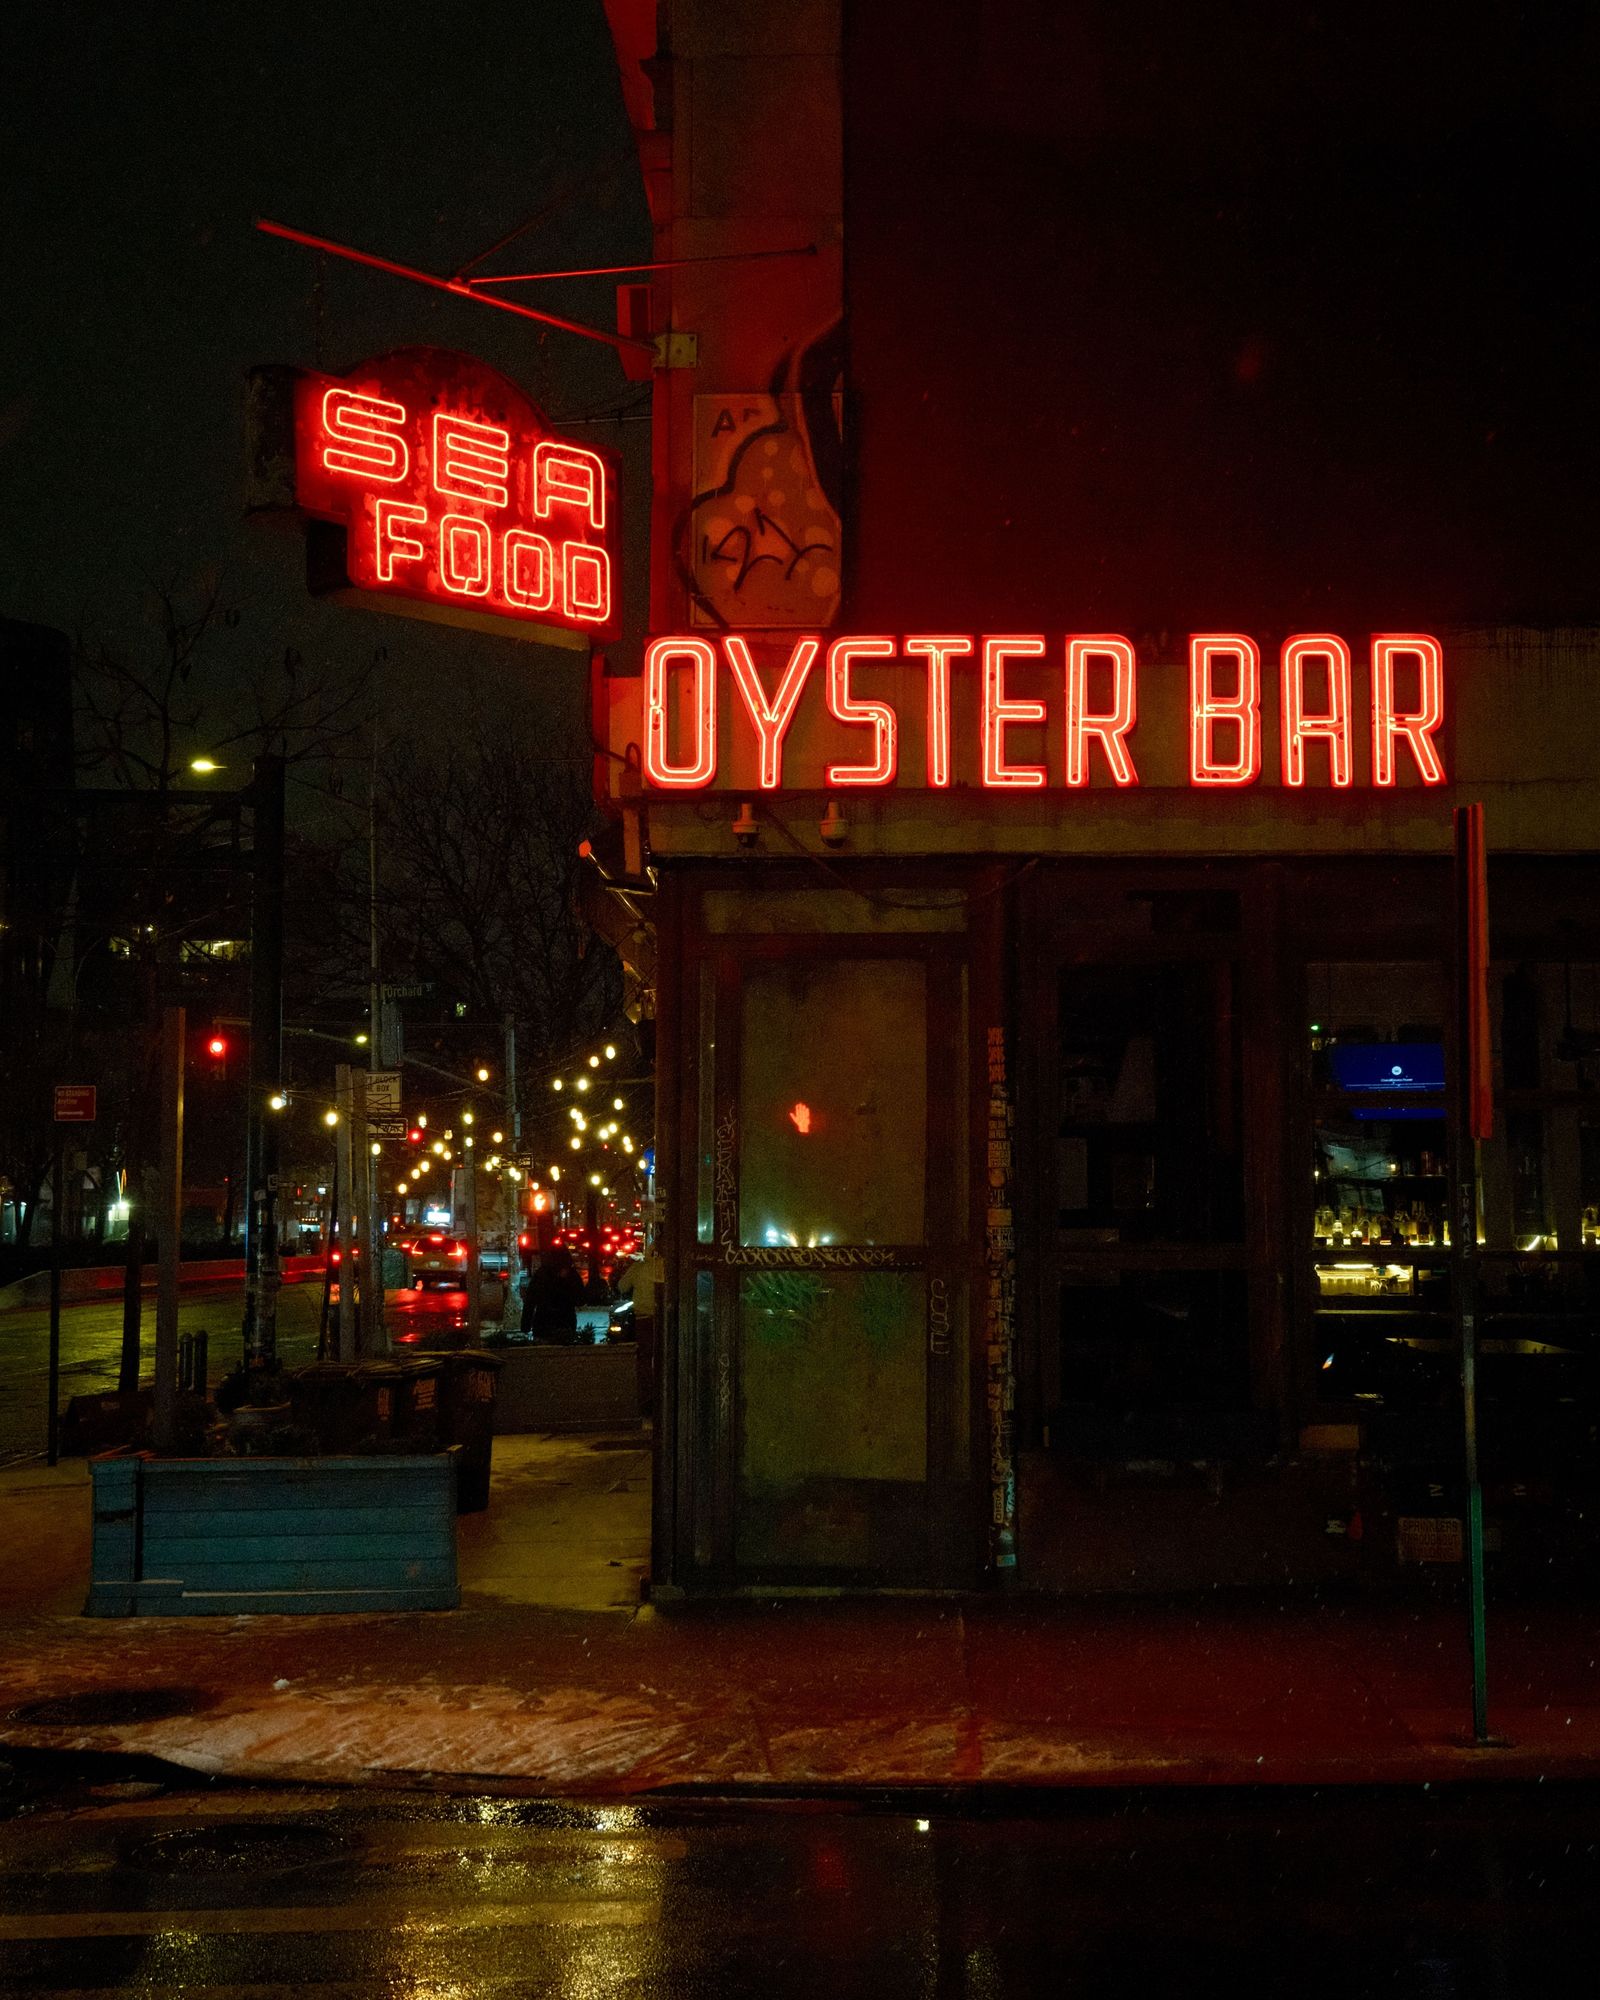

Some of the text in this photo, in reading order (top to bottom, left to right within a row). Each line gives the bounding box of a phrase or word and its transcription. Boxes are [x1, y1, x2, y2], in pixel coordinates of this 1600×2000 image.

[321, 387, 606, 530] SEA
[375, 497, 611, 623] FOOD
[643, 633, 1447, 789] OYSTER BAR
[387, 984, 422, 998] Orchard
